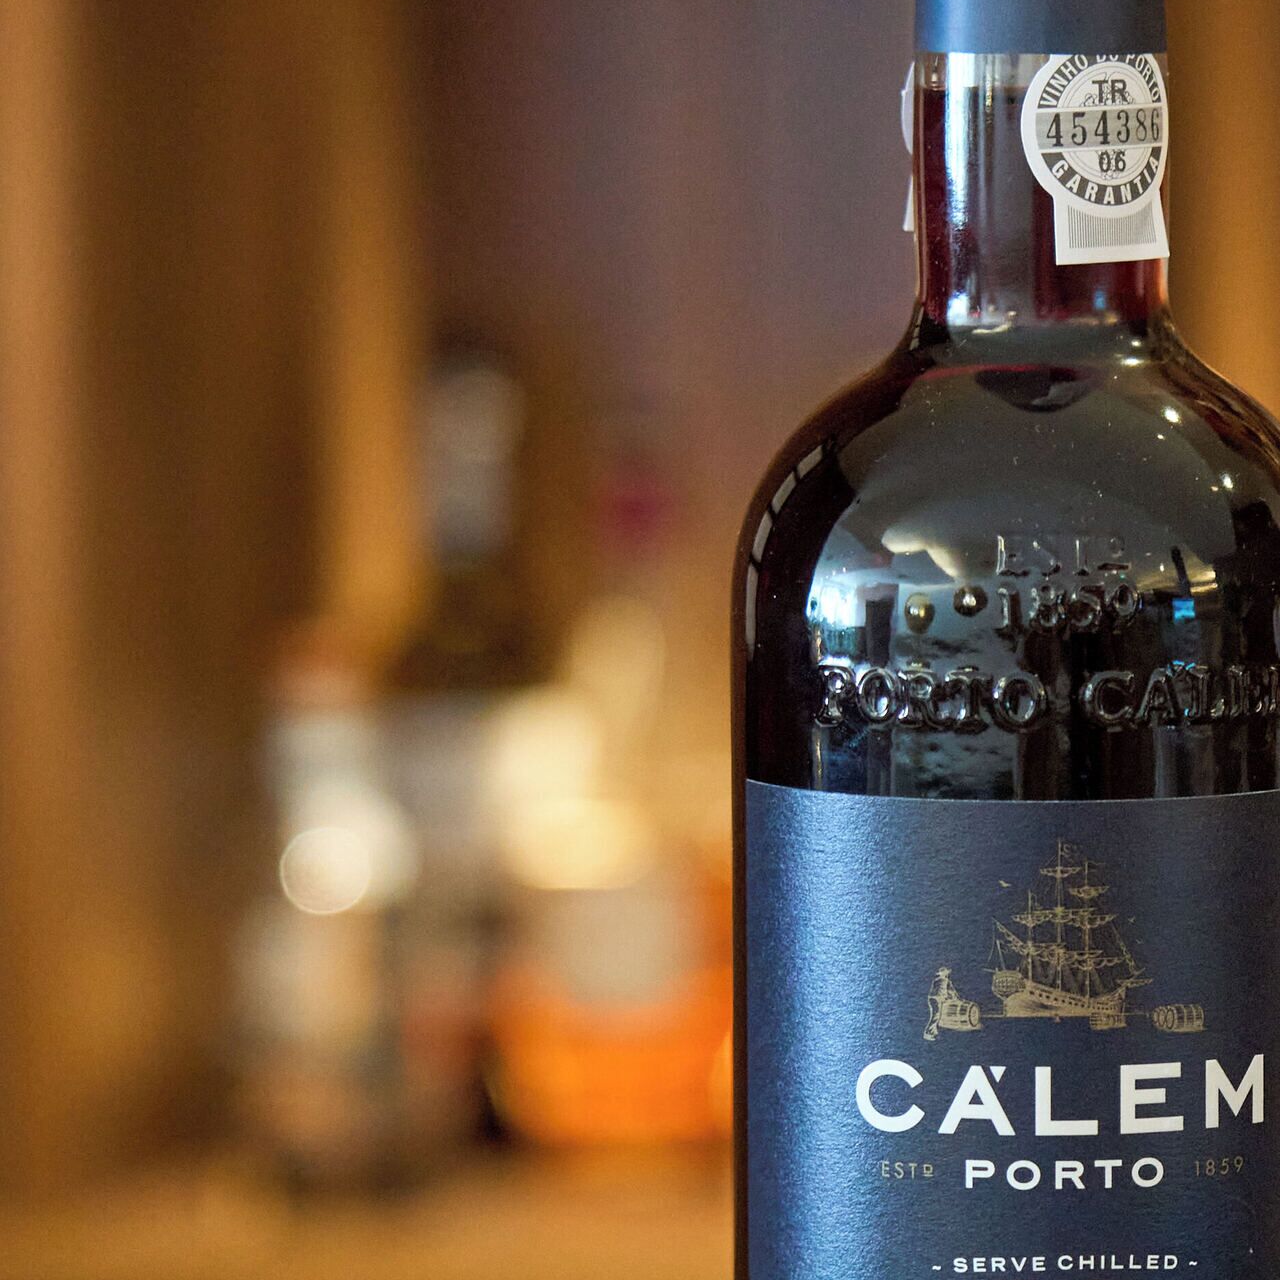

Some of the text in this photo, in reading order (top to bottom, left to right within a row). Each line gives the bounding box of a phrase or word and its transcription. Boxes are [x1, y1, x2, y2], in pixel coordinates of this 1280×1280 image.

[1040, 54, 1088, 104] VINHO
[1092, 79, 1129, 104] TR
[1046, 108, 1160, 148] 454386
[1052, 156, 1159, 206] GARANTIA
[815, 662, 1047, 728] PORTO
[965, 1157, 1165, 1191] PORTO
[1194, 1156, 1244, 1177] 1859
[953, 1254, 1178, 1273] SERVE CHILLED
